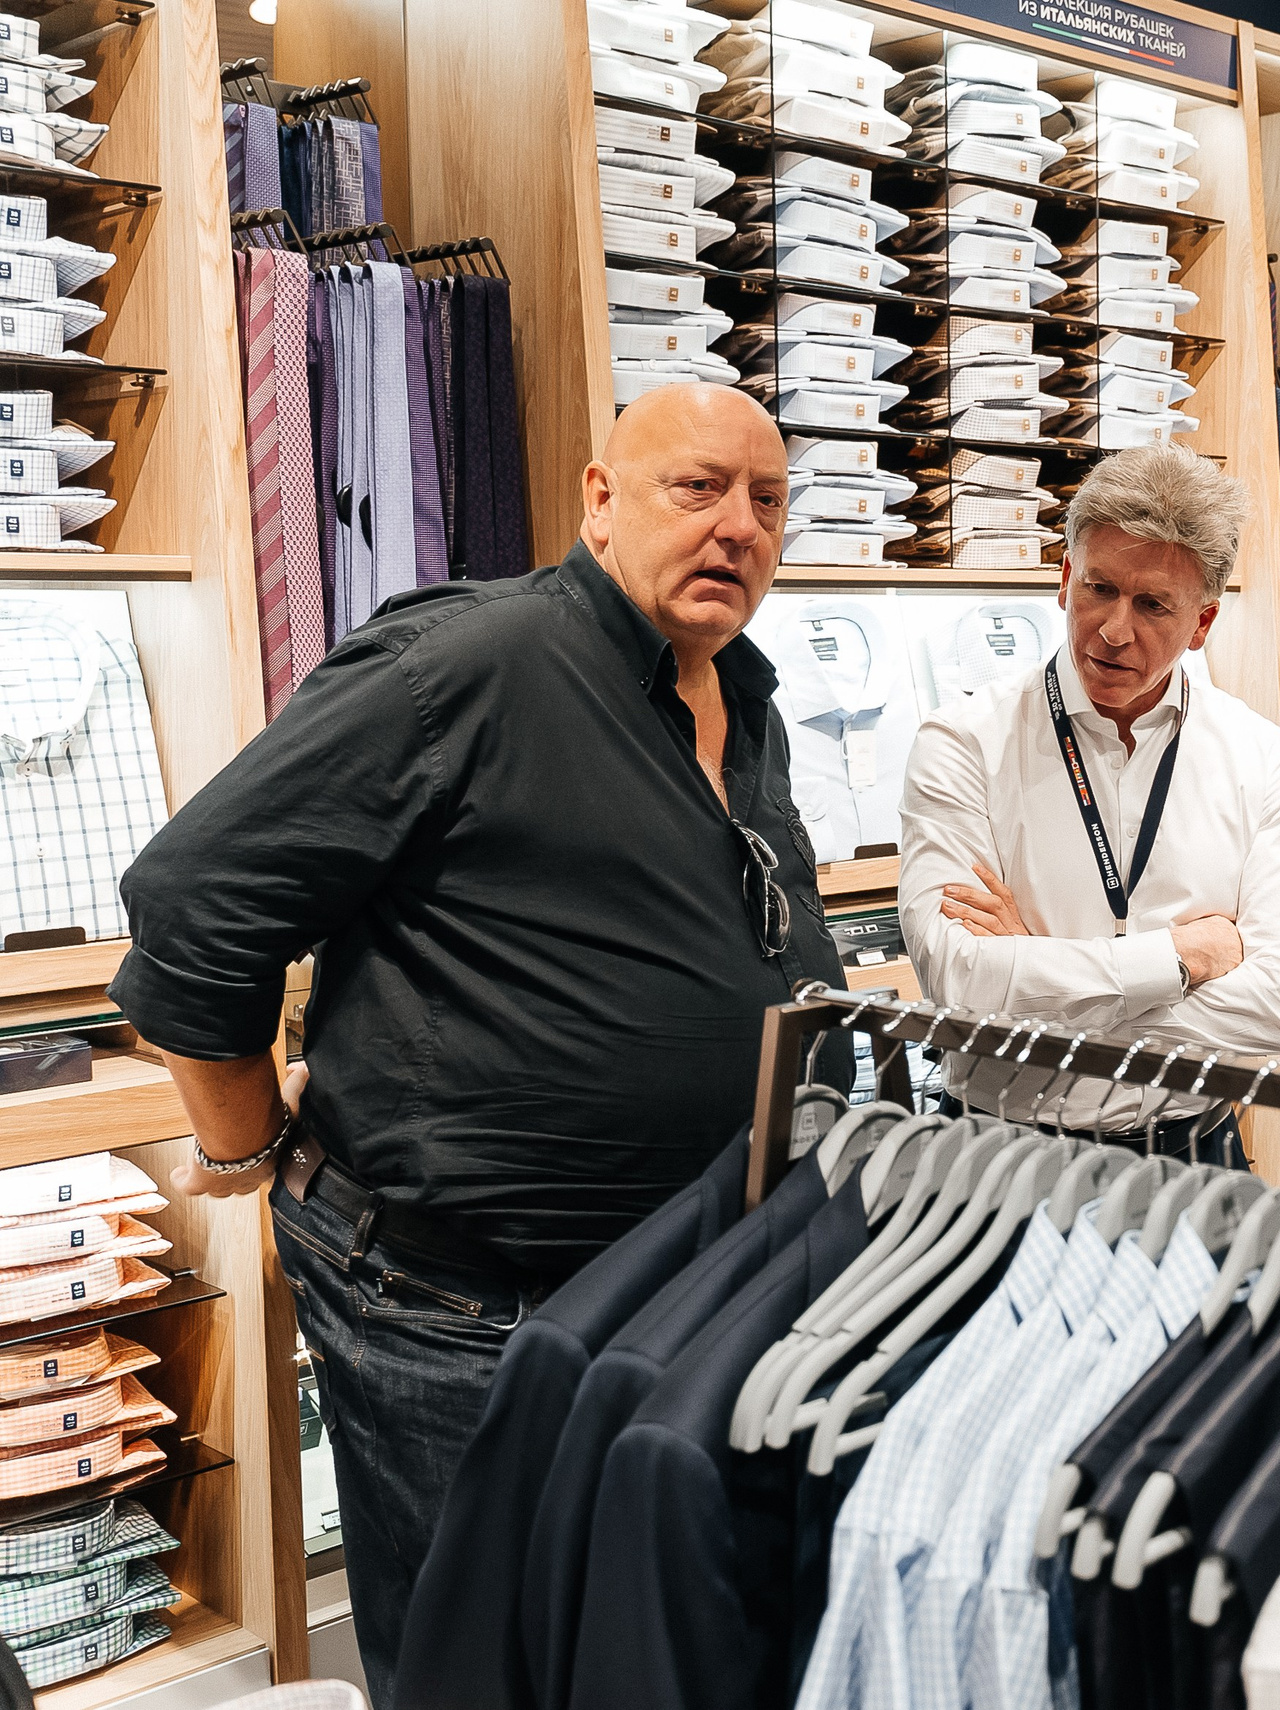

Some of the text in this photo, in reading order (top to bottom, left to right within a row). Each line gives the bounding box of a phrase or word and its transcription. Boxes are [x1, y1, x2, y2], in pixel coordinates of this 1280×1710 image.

[1018, 0, 1186, 59] ИЗ ИТАЛЬЯНСКИХ ТКАНЕЙ
[1114, 9, 1175, 40] РУБАШЕК
[1047, 677, 1059, 712] 30 YEARS
[1091, 823, 1114, 877] HENDERSON
